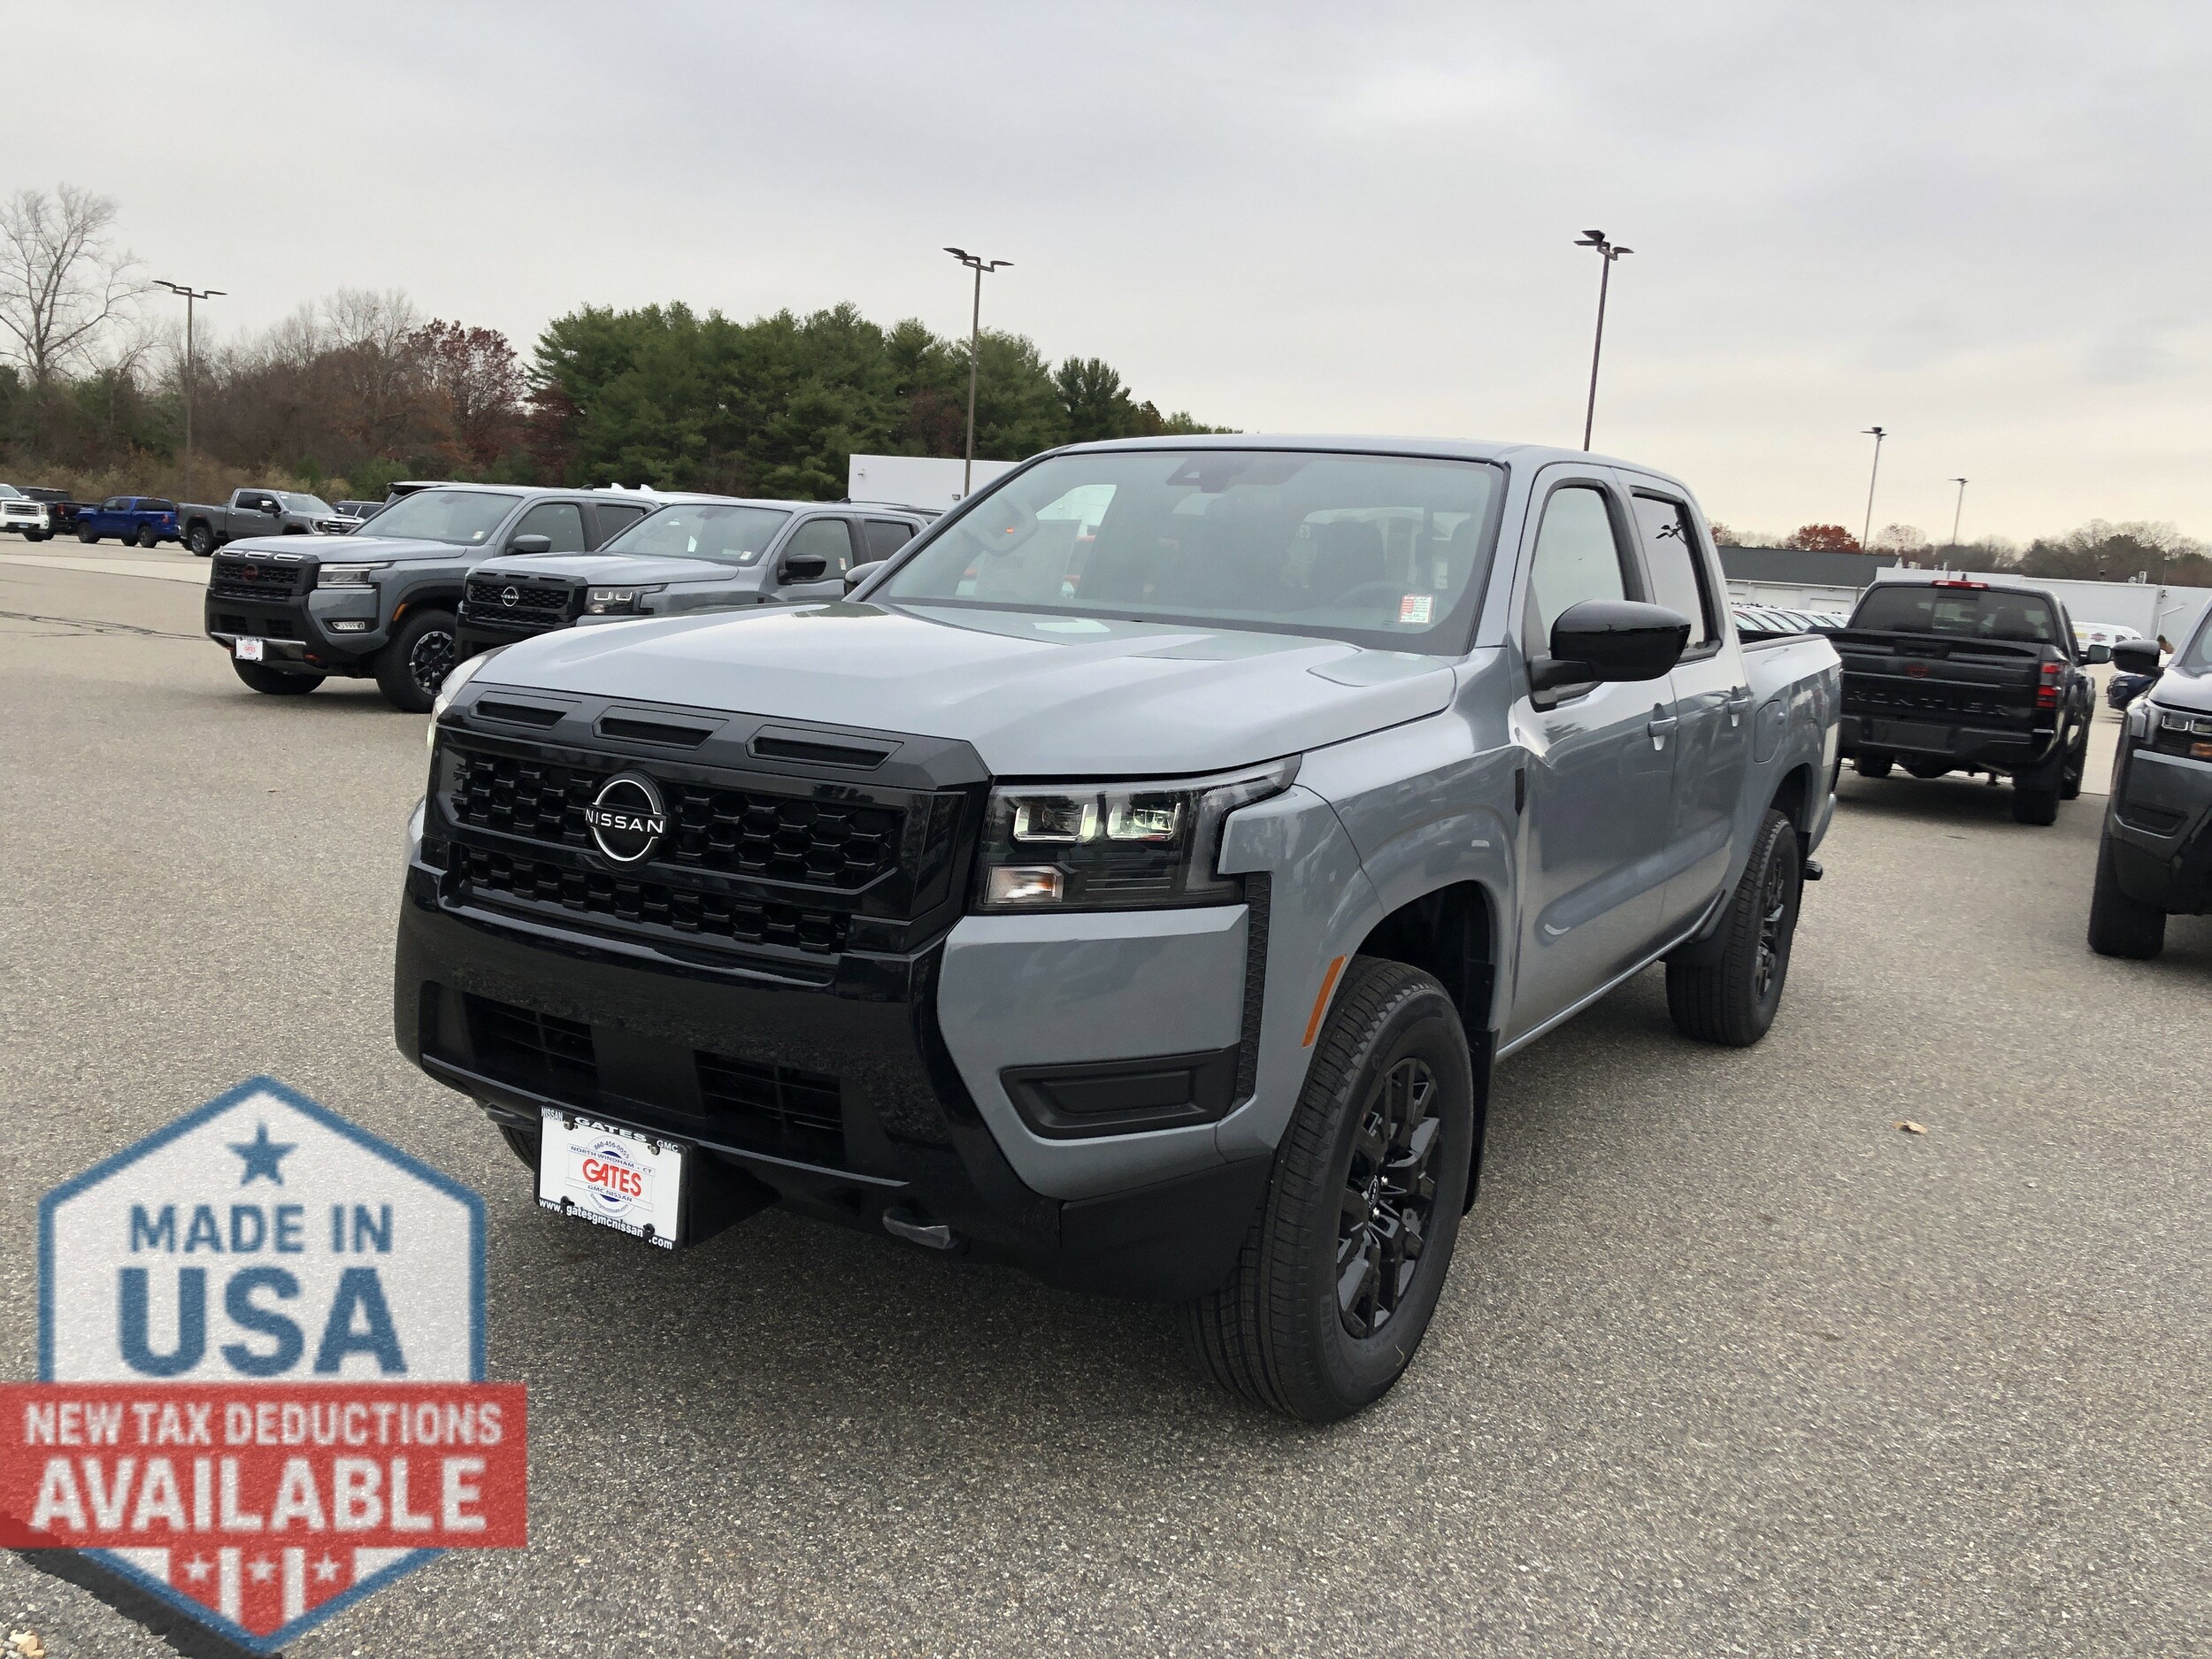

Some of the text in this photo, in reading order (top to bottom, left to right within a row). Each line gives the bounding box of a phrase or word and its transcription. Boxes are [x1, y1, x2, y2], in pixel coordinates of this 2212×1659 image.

[585, 809, 664, 833] NISSAN
[541, 1107, 679, 1152] NISSAN GATES GMC
[571, 1146, 596, 1157] NORTH
[597, 1153, 635, 1169] WINDHAM
[582, 1158, 641, 1197] GATES
[588, 1184, 633, 1202] GMC NISSAN
